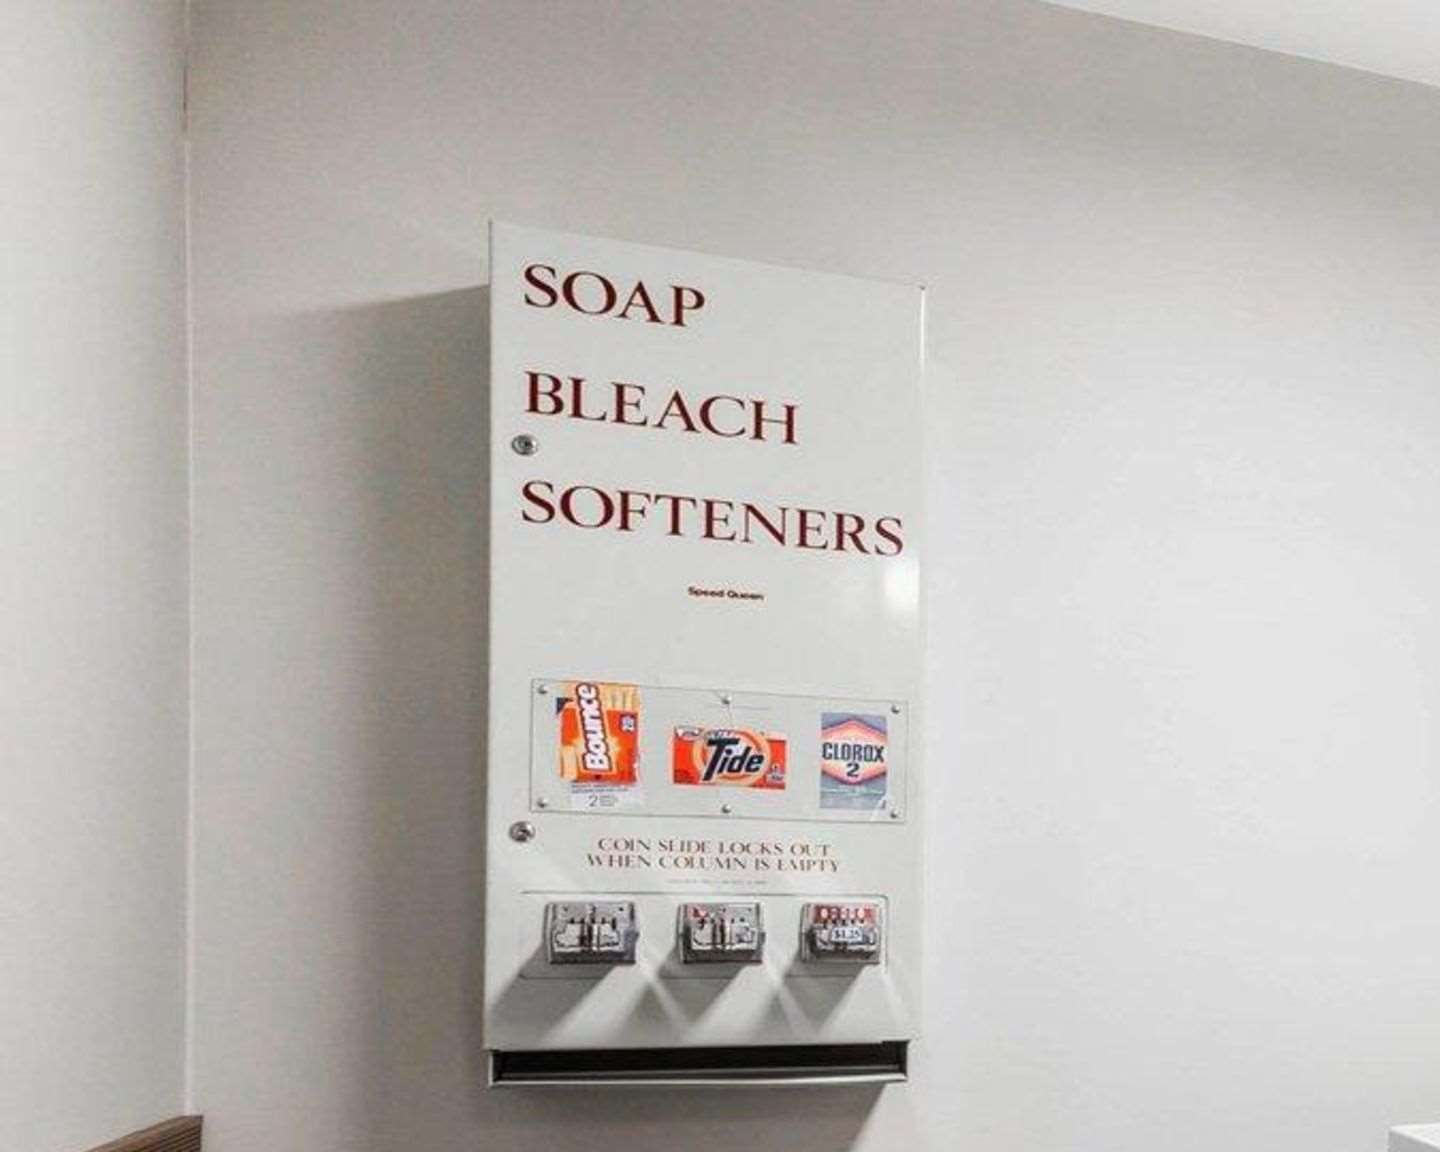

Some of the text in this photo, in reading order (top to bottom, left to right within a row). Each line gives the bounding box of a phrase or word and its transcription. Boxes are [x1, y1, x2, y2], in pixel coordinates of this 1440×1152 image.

[523, 263, 705, 327] SOAP
[525, 371, 799, 444] BLEACH
[521, 480, 904, 557] SOFTENERS
[687, 586, 764, 601] Speed Queen
[702, 738, 764, 781] Tide
[822, 742, 885, 762] CLOROX
[846, 762, 860, 778] 2
[598, 838, 832, 857] COIN SLIDE LOCKS OUT
[587, 853, 839, 873] WHEN COLUMN IS EMPTY
